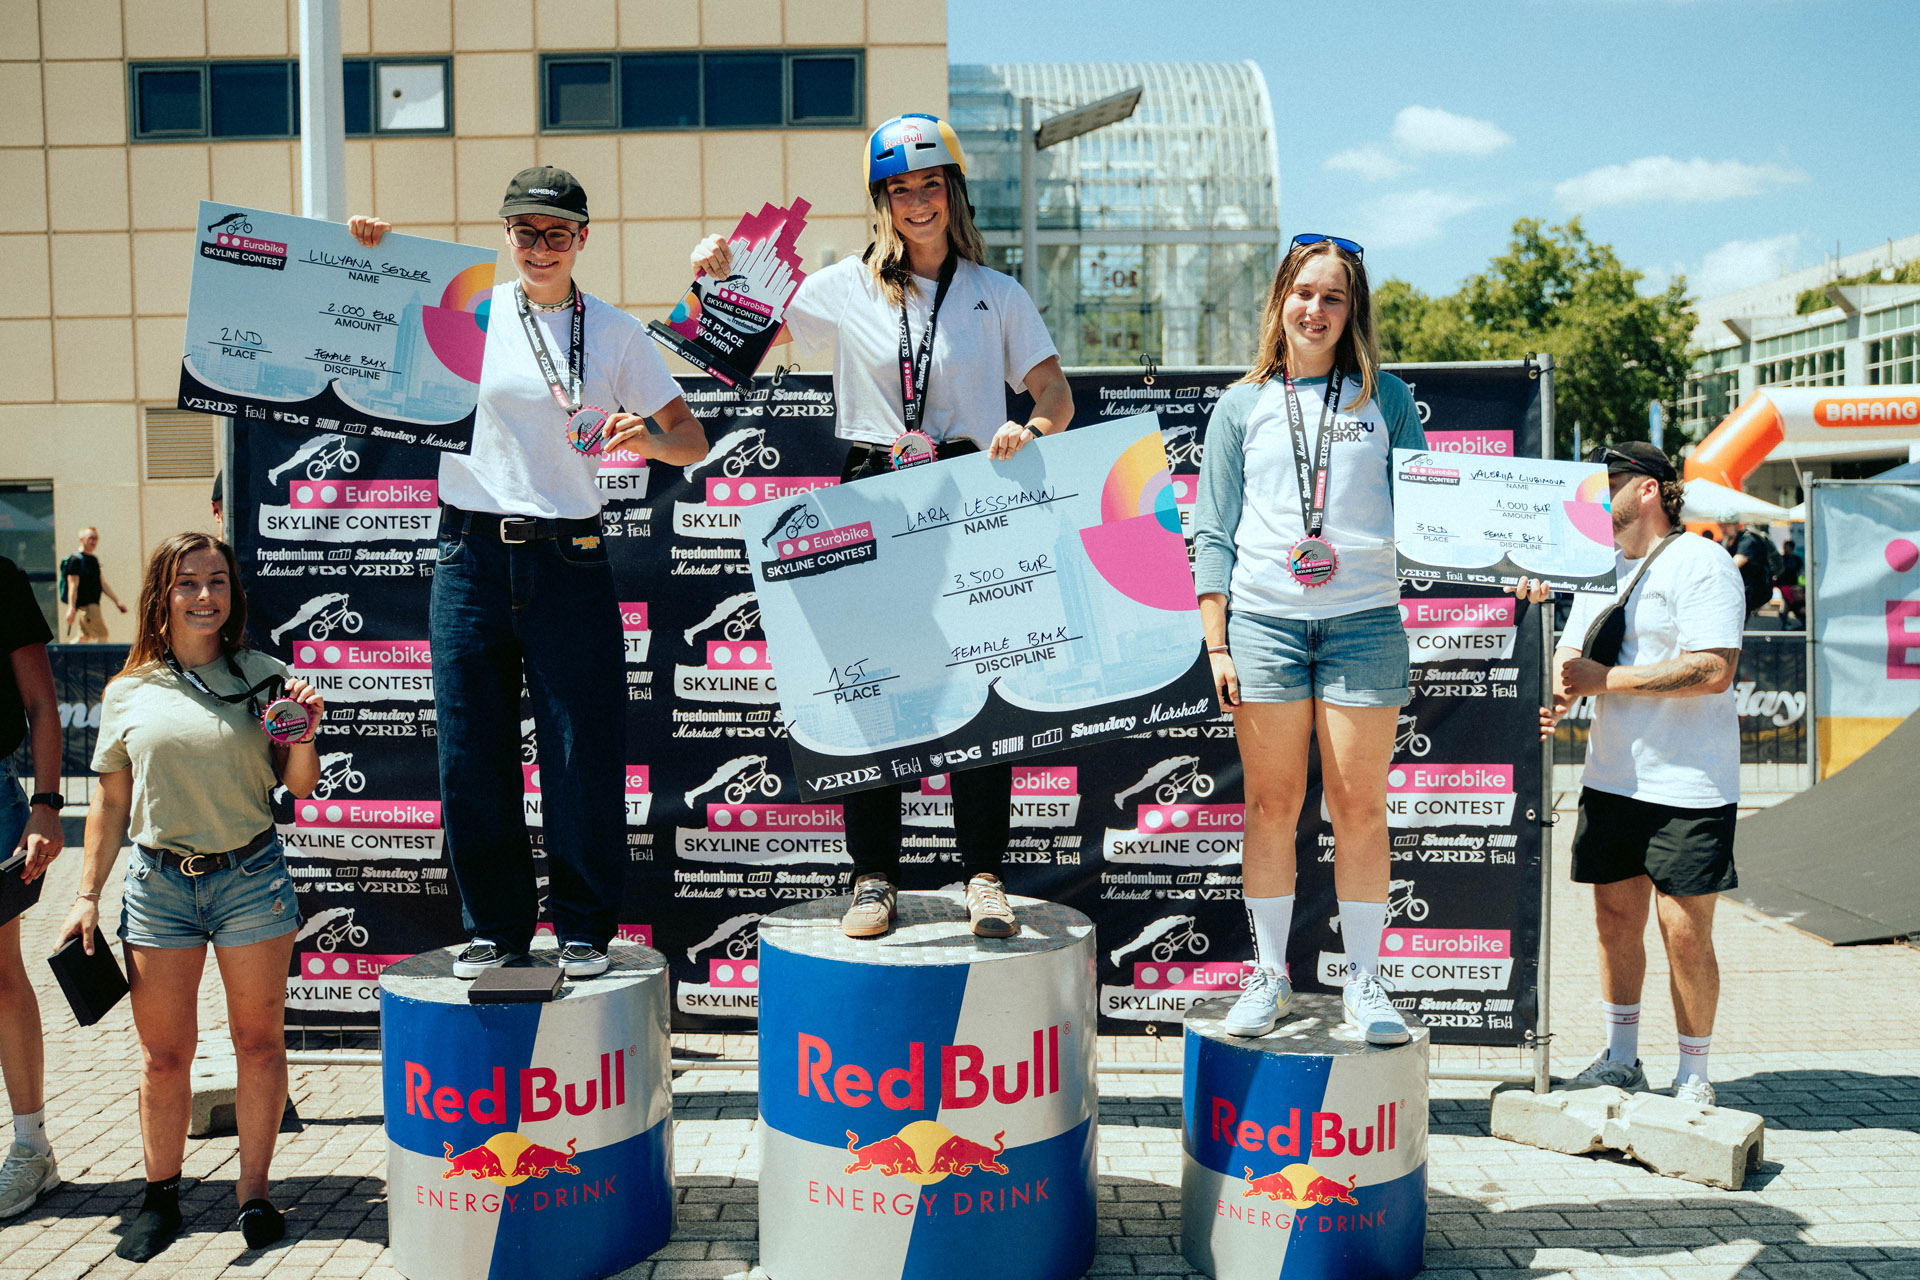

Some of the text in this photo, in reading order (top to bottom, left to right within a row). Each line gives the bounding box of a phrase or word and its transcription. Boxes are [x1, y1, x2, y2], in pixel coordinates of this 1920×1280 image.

[884, 133, 923, 150] Red Bull
[528, 188, 559, 196] HOMEBOY
[242, 238, 285, 255] Eurobike
[204, 246, 283, 267] SKYLINE CONTEST
[309, 249, 373, 272] LILLYANA
[348, 270, 380, 285] NAME
[706, 297, 768, 324] SKYLINE CONTEST
[738, 297, 771, 315] Eurobike
[373, 309, 398, 325] EUR
[334, 318, 383, 334] AMOUNT
[696, 313, 745, 348] 1st PLACE
[221, 327, 263, 346] 2ND
[695, 325, 734, 355] WOMEN
[222, 347, 257, 361] PLACE
[360, 356, 386, 371] BMX
[324, 364, 381, 381] DISCIPLINE
[771, 388, 833, 404] Sunday
[1099, 386, 1171, 400] freedombmx
[735, 405, 764, 417] TSG
[1100, 402, 1195, 417] Marshall TSG
[1826, 402, 1918, 422] BAFANG
[371, 425, 417, 444] Sunday
[420, 433, 467, 452] Marshall
[1331, 431, 1362, 443] BMX
[1429, 436, 1507, 454] urobike
[1400, 473, 1459, 486] SKYLINE CONTEST
[1427, 467, 1459, 477] Eurobike
[345, 486, 432, 503] Eurobike
[906, 486, 1056, 532] LARA LESSMANN
[1502, 512, 1537, 520] AMOUNT
[266, 515, 432, 530] SKYLINE CONTEST
[963, 514, 1009, 536] NAME
[813, 525, 870, 550] Eurobike
[1423, 535, 1449, 543] PLACE
[1499, 541, 1543, 551] DISCIPLINE
[256, 548, 414, 564] freedombmx Sunday
[670, 546, 742, 560] freedombmx
[257, 562, 305, 577] Marshall
[319, 565, 347, 576] TSG
[671, 561, 721, 576] Marshall
[766, 544, 873, 580] SKYLINE CONTEST
[955, 553, 1053, 590] 3.500 EUR
[968, 580, 1034, 606] AMOUNT
[1580, 581, 1617, 593] Marshall
[1417, 605, 1509, 622] Eurobike
[951, 625, 1070, 662] FEMALE BMX
[1416, 634, 1507, 649] CONTEST
[348, 646, 432, 664] Eurobike
[975, 647, 1057, 675] DISCIPLINE
[828, 658, 869, 691] 1ST
[1424, 667, 1486, 684] Sunday
[348, 676, 433, 691] CONTEST
[683, 676, 758, 691] SKYLINE
[834, 683, 882, 705] PLACE
[1734, 681, 1807, 727] day
[357, 708, 416, 724] Sunday
[672, 709, 743, 724] freedombmx
[672, 725, 766, 739] Marshall TSG
[944, 744, 982, 766] TSG
[1070, 714, 1137, 740] Sunday
[1144, 698, 1208, 726] Marshall
[1168, 727, 1198, 738] TSG
[1414, 770, 1506, 788] Eurobike
[350, 806, 435, 824] Eurobike
[1414, 800, 1506, 815] CONTEST
[278, 833, 436, 850] SKYLINE CONTEST
[684, 838, 760, 853] SKYLINE
[1112, 839, 1190, 855] SKYLINE
[1421, 833, 1485, 850] Sunday
[361, 866, 419, 882] Sunday
[674, 869, 744, 884] freedombmx
[774, 870, 836, 887] Sunday
[1100, 871, 1172, 885] freedombmx
[326, 882, 355, 892] TSG
[674, 884, 725, 899] Marshall
[738, 887, 767, 899] TSG
[1100, 886, 1196, 900] Marshall TSG
[1412, 934, 1504, 953] Eurobike
[1411, 965, 1503, 980] CONTEST
[285, 986, 352, 1000] SKYLINE
[685, 993, 758, 1008] SKYLINE
[1108, 996, 1186, 1011] SKYLINE
[1417, 997, 1482, 1014] Sunday
[798, 1024, 1060, 1111] Red Bull
[405, 1048, 626, 1124] Red Bull
[1212, 1096, 1396, 1158] Red Bull
[416, 1175, 617, 1214] ENERGY DRINK
[808, 1177, 1050, 1216] ENERGY DRINK
[1217, 1199, 1387, 1233] ENERGY DRINK
